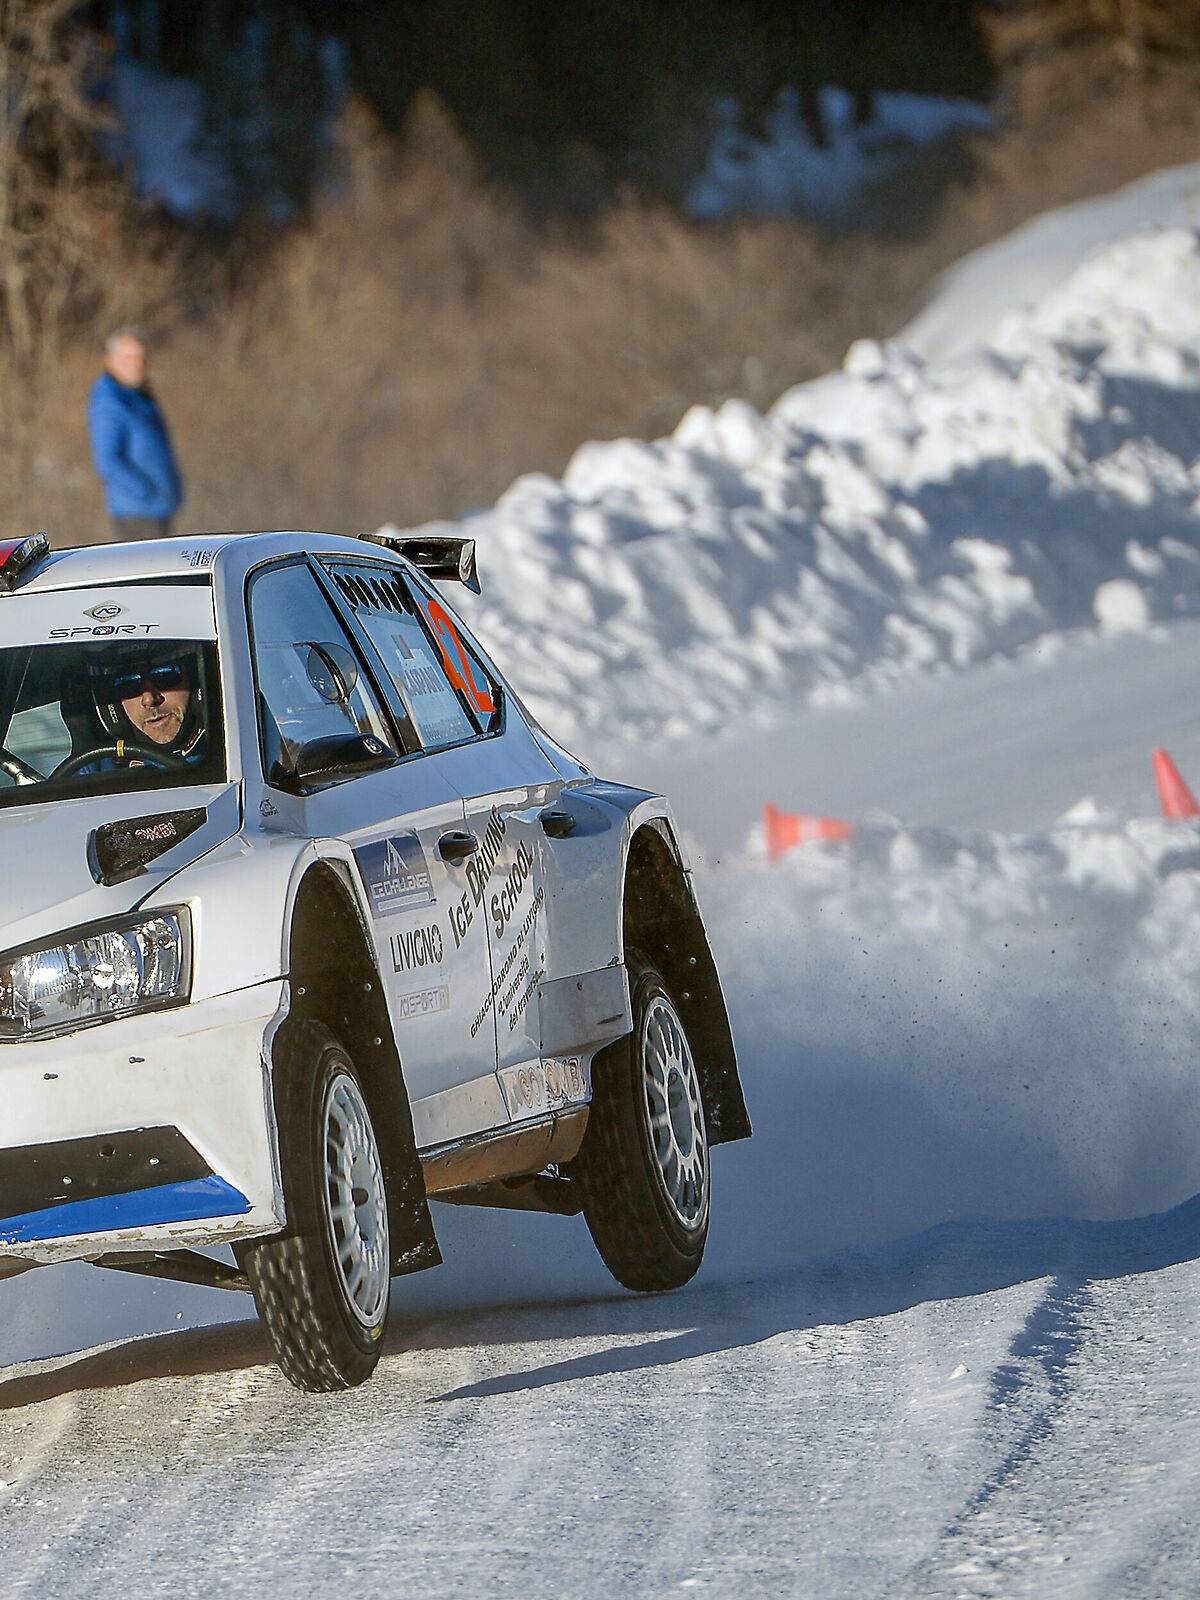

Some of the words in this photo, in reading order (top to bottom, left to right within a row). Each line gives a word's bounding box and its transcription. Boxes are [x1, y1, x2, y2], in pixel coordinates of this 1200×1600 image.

[48, 624, 160, 640] SPORT
[448, 891, 474, 950] ICE
[465, 804, 508, 909] DRIVING
[491, 839, 534, 940] SCHOOL
[389, 923, 443, 974] LIVIGNO
[517, 1055, 587, 1110] COOMBI
